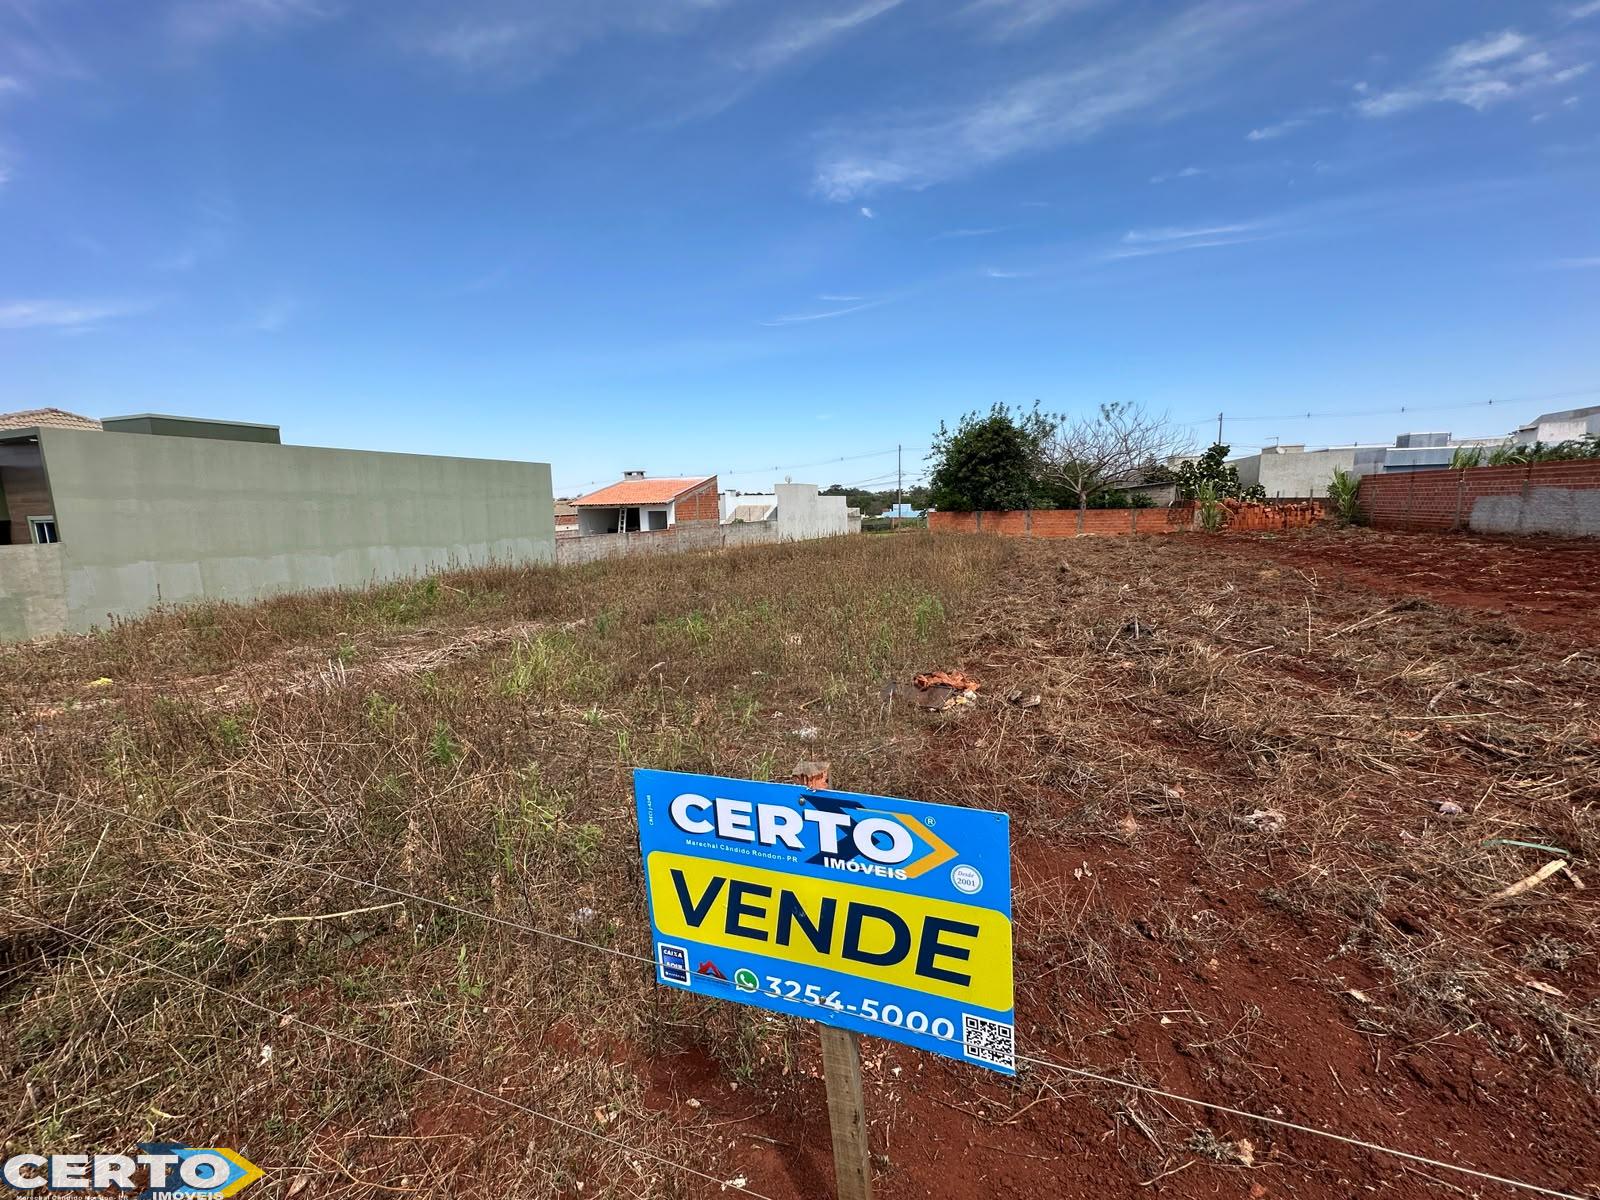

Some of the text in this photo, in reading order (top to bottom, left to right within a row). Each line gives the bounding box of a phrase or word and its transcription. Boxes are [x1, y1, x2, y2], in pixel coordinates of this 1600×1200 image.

[669, 793, 914, 864] CERTO
[685, 839, 718, 849] Marechal
[719, 844, 751, 855] Cândido
[823, 856, 908, 881] IMÓVEIS
[957, 870, 975, 878] Desde
[956, 877, 976, 887] 2001
[669, 868, 980, 987] VENDE
[663, 949, 683, 958] CAIXA
[764, 976, 955, 1041] 3254-5000
